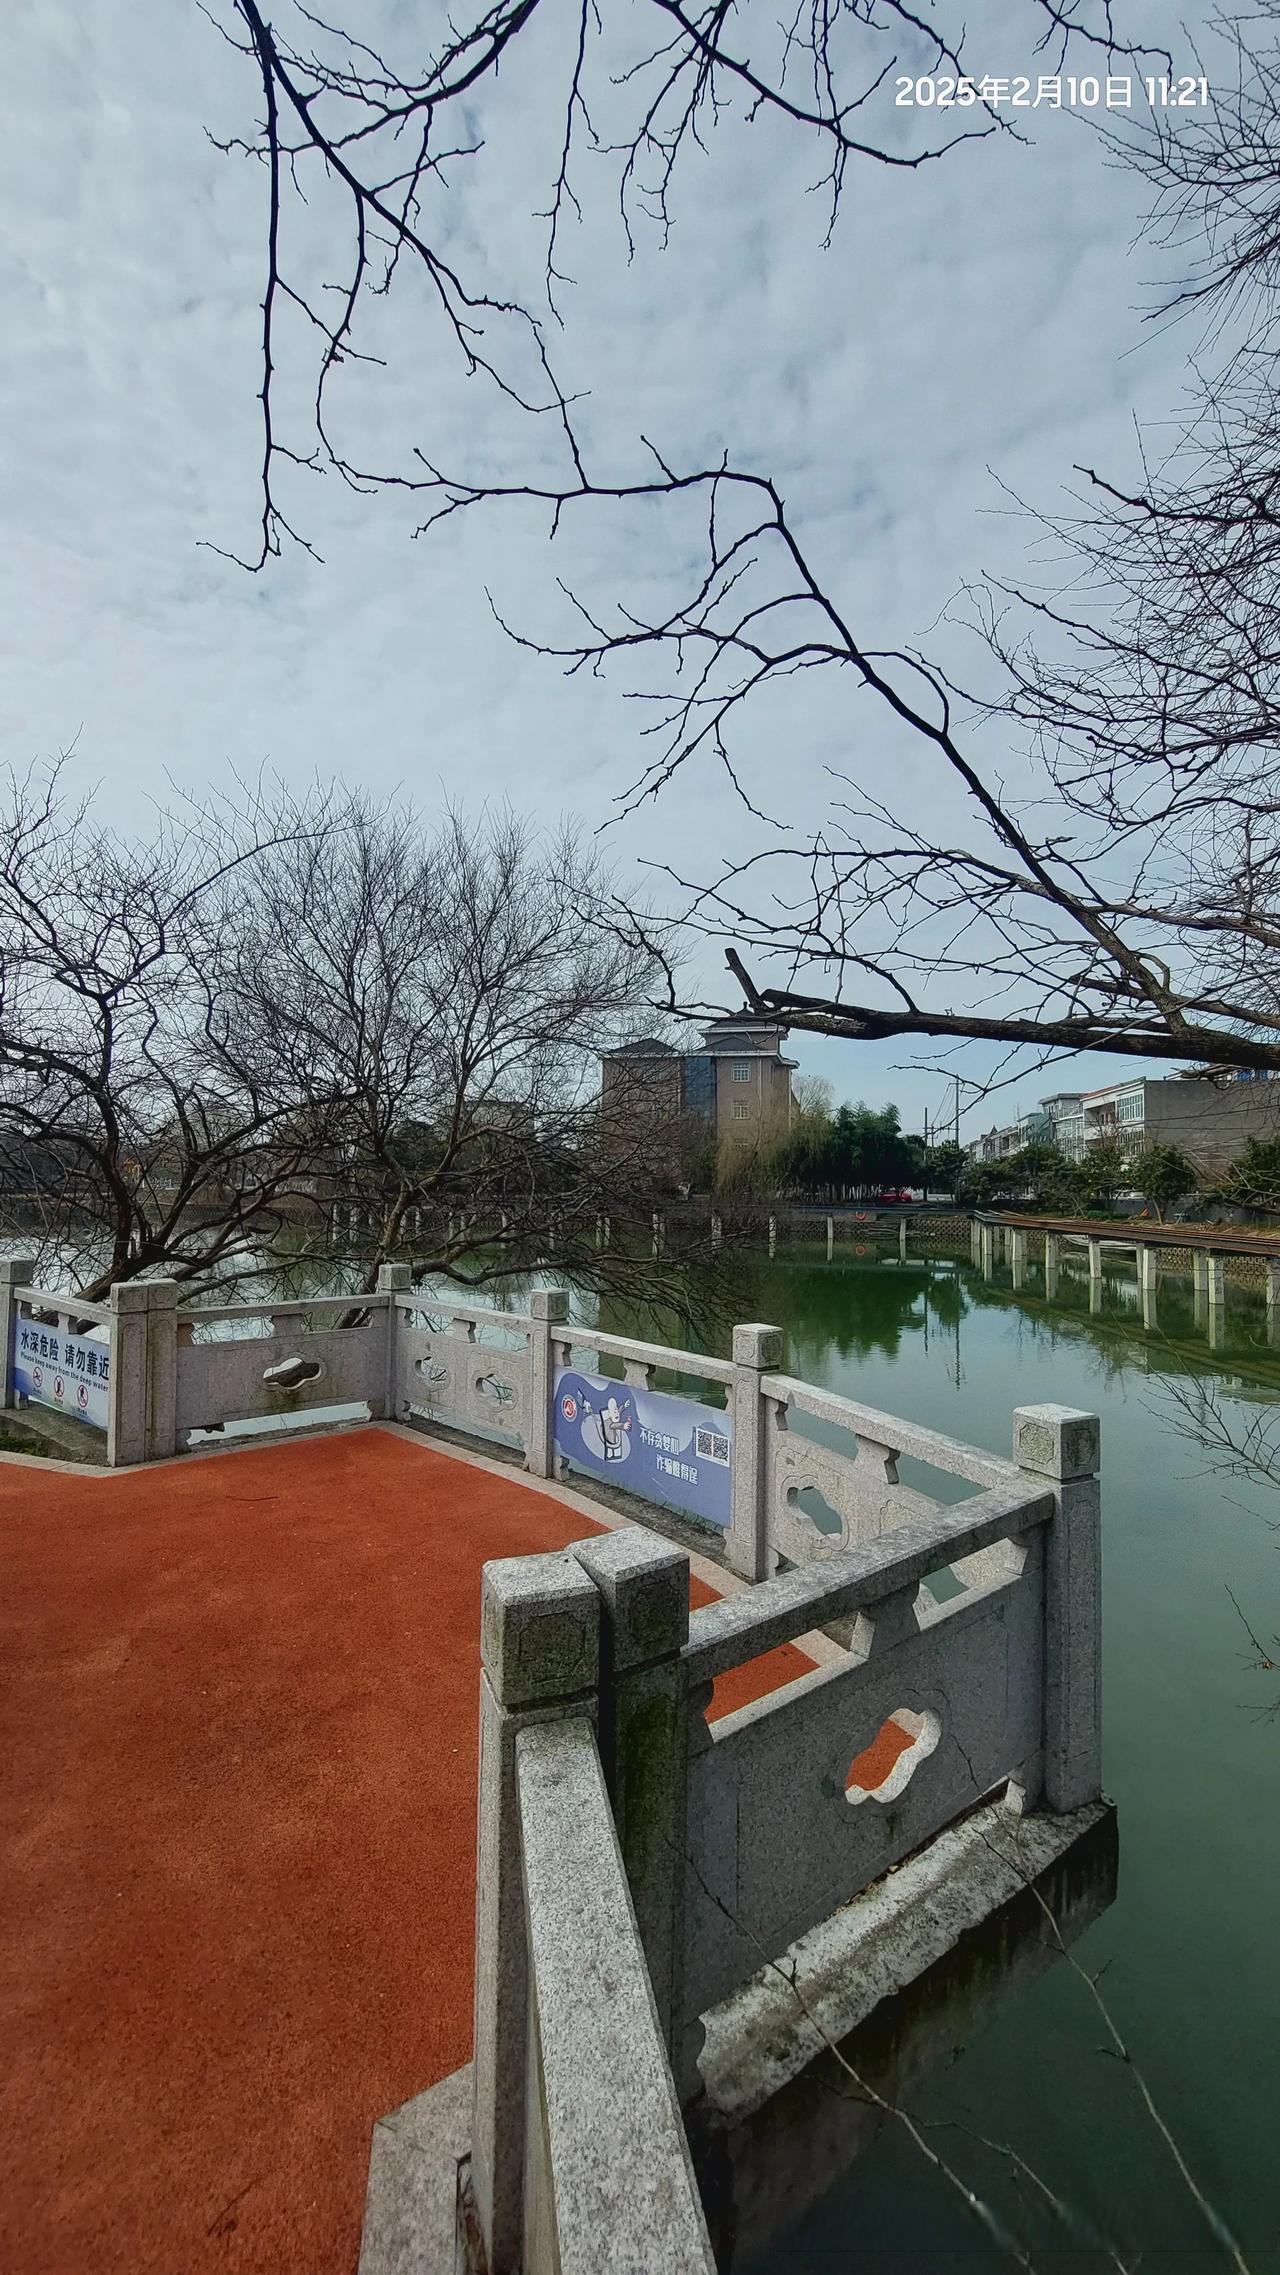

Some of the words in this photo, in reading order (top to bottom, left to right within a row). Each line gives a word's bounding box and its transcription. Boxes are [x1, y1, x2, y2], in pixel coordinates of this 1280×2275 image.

[20, 1328, 60, 1361] 水深危险
[65, 1344, 110, 1381] 请勿靠近
[20, 1351, 34, 1363] Please
[35, 1356, 44, 1368] keep
[45, 1362, 57, 1373] away
[58, 1366, 70, 1377] from
[71, 1370, 79, 1381] the
[80, 1374, 91, 1387] deep
[93, 1380, 109, 1392] water
